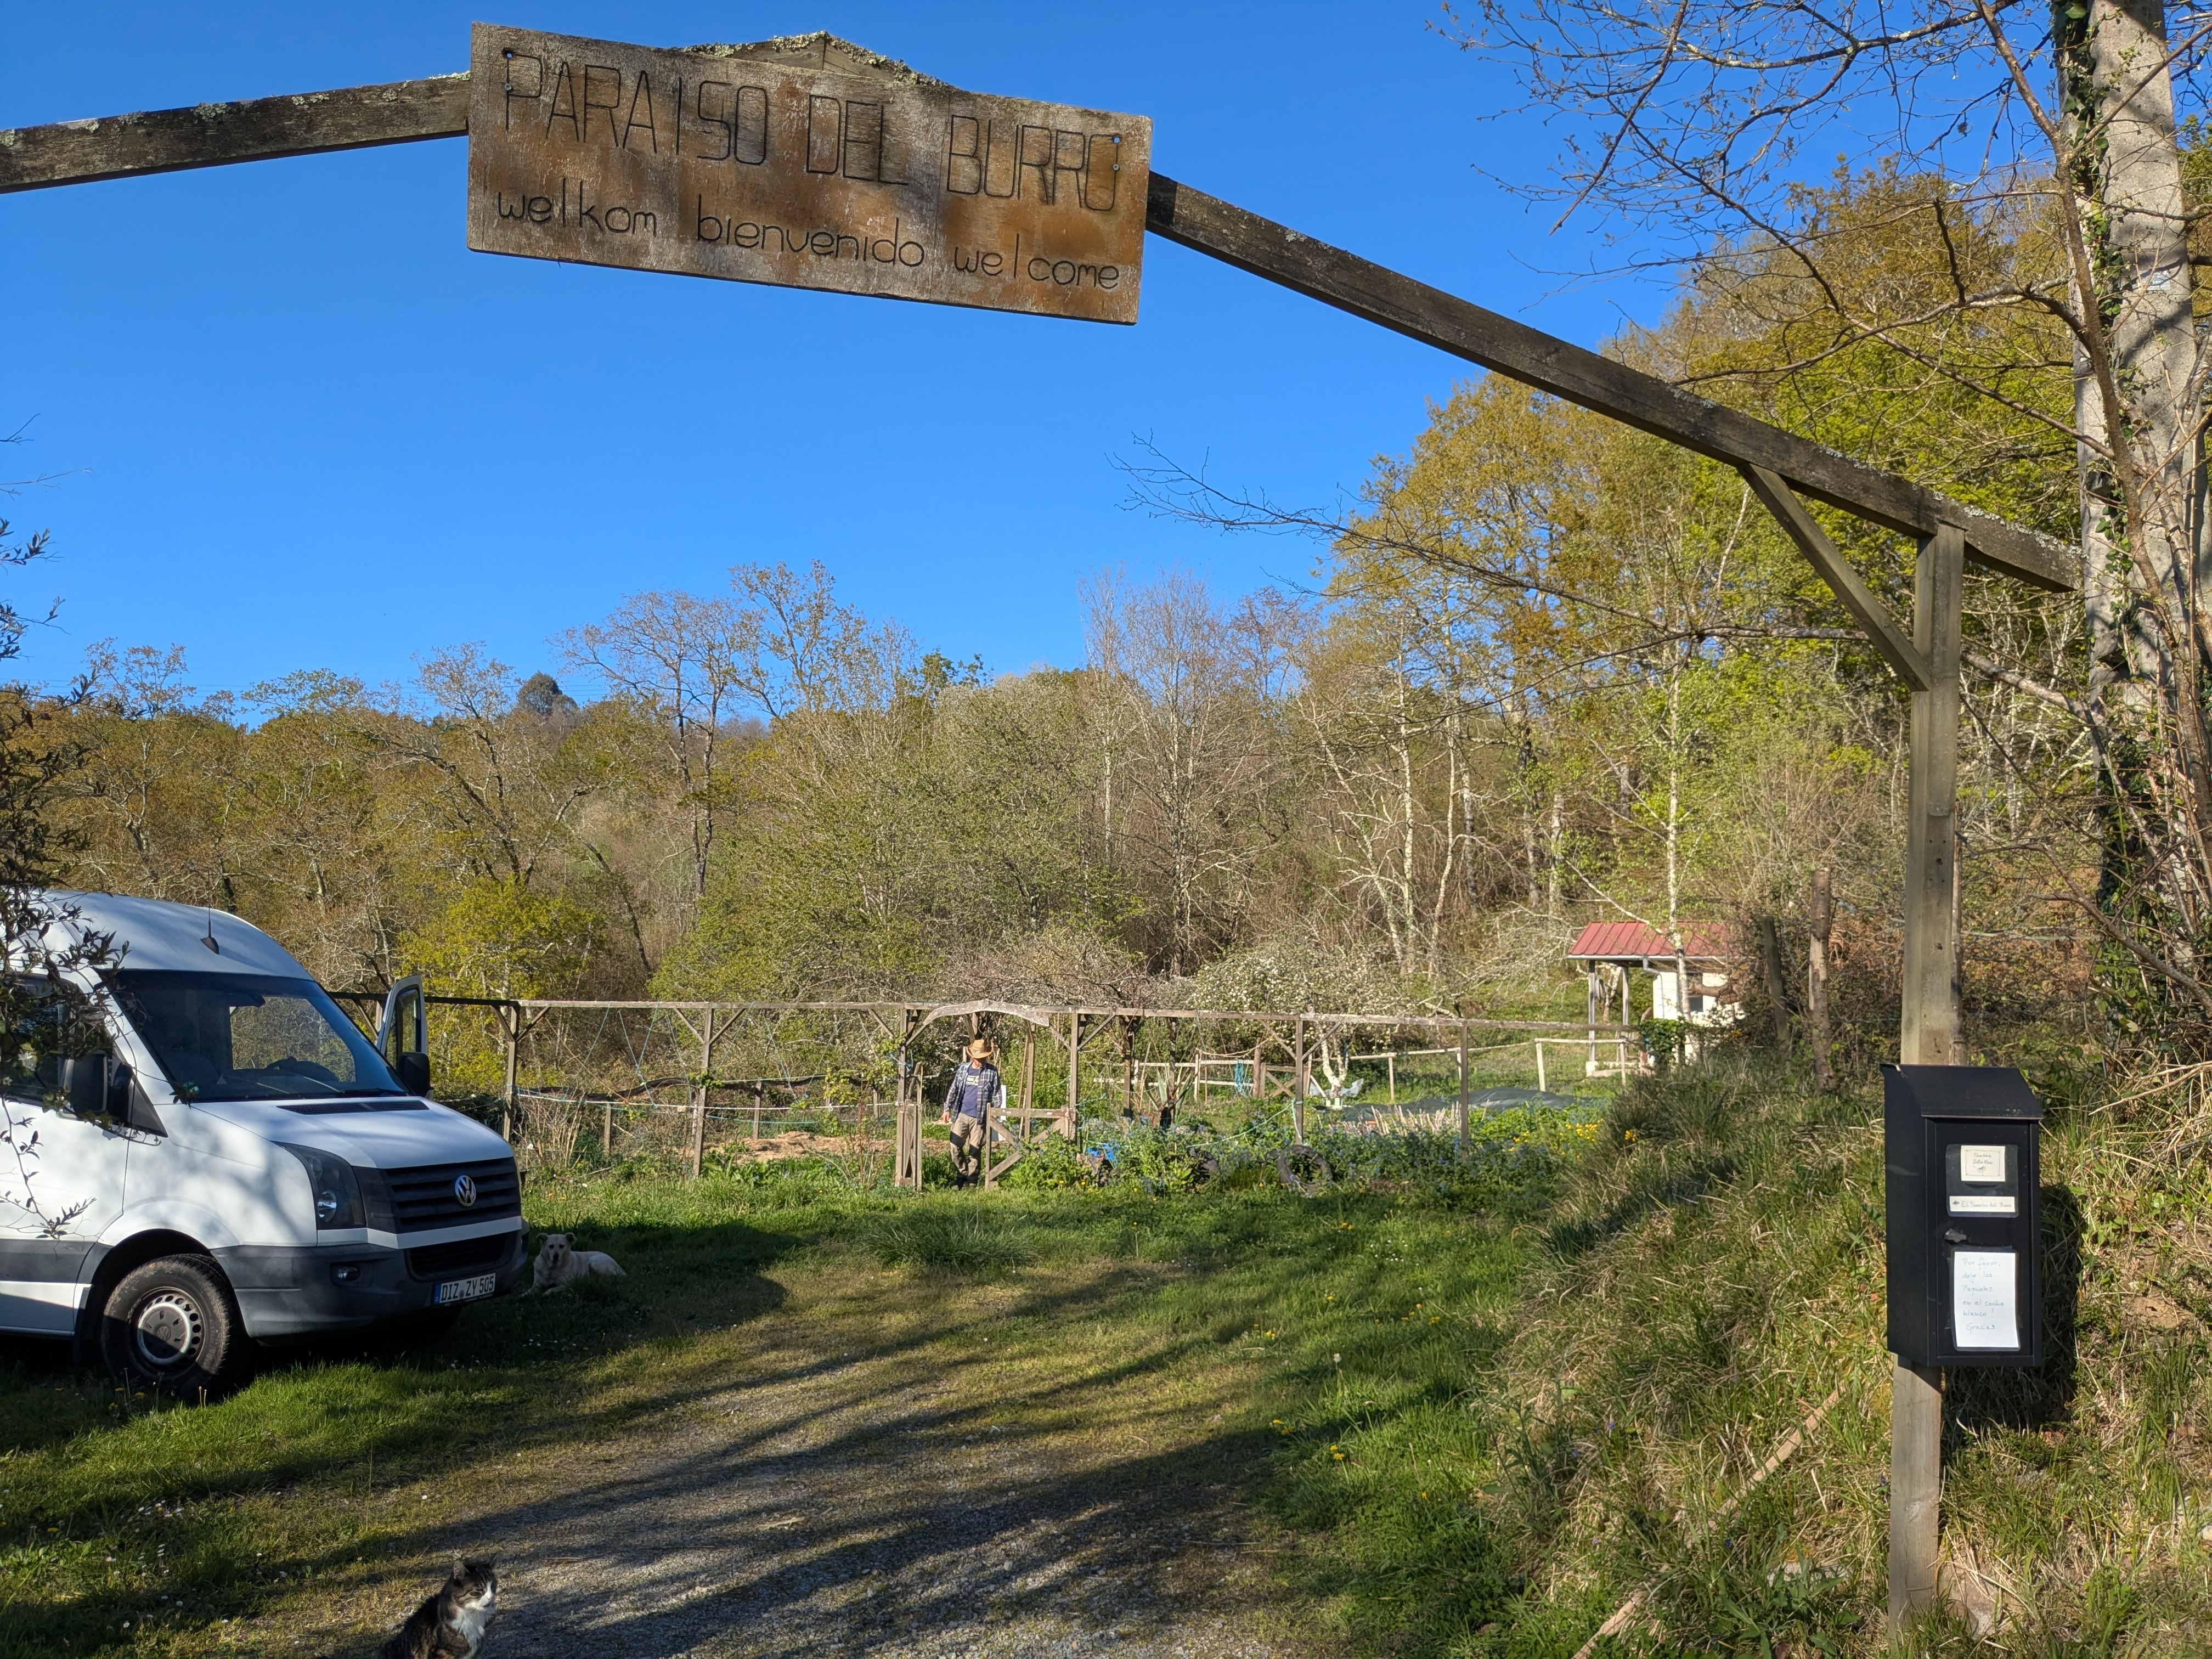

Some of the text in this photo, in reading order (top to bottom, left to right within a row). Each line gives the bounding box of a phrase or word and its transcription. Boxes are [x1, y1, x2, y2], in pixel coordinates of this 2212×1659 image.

[505, 53, 1120, 211] PARAISO DEL BURRO
[498, 177, 1120, 290] welkom bienvenido welcome
[1962, 1257, 1975, 1266] Por
[441, 1283, 459, 1301] DIZ
[465, 1279, 477, 1297] ZY
[479, 1276, 494, 1294] 505
[1966, 1323, 1995, 1334] Gracias
